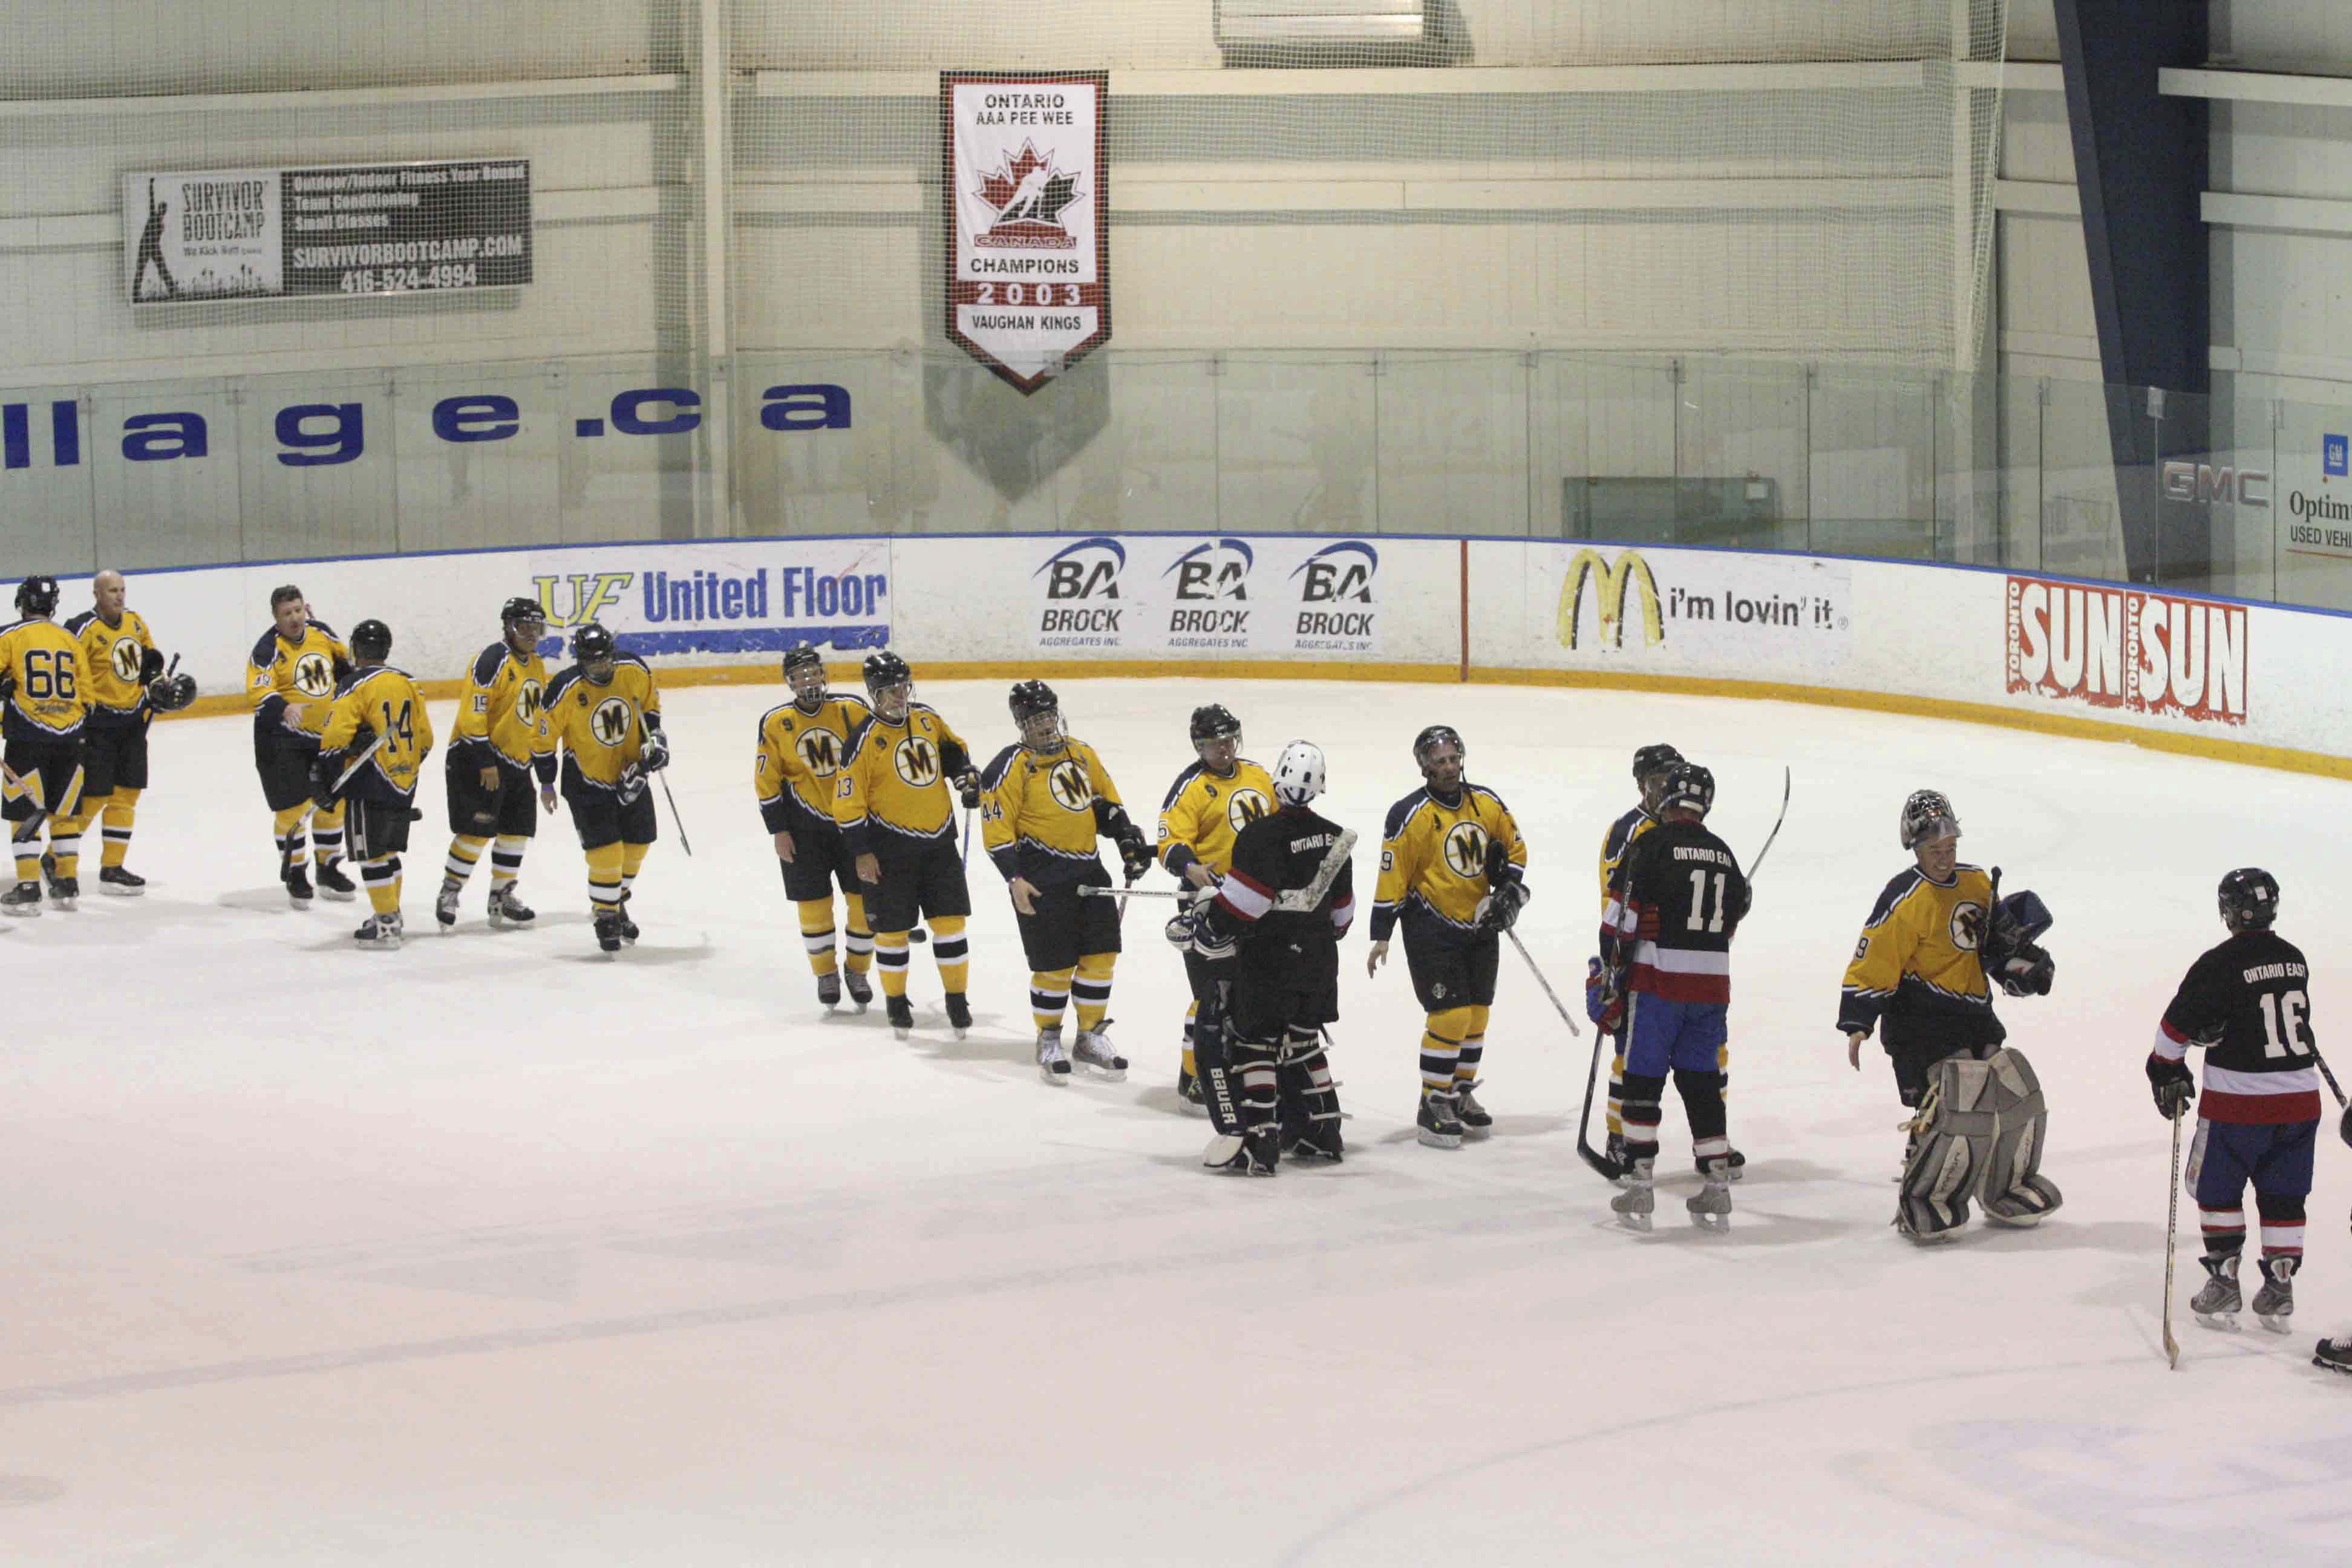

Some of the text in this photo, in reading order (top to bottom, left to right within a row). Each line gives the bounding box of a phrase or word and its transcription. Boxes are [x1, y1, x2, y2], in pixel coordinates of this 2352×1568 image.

[984, 94, 1065, 109] ONTARIO
[976, 111, 1074, 126] AAA PEE WEE
[182, 181, 264, 213] SURVIVOR
[183, 212, 266, 241] BOOTCAMP
[975, 235, 1076, 249] CANADA
[292, 235, 523, 269] SURVIVORBOOTCAMP.COM
[970, 258, 1080, 274] CHAMPIONS
[341, 264, 477, 293] 416-524-4994
[976, 283, 1081, 305] 2003
[972, 315, 1082, 330] VAUGHAN KINGS
[2163, 461, 2270, 508] GMC
[2289, 490, 2352, 523] Optim
[2290, 524, 2352, 547] USED VEHI
[642, 566, 887, 623] United Floor
[1047, 561, 1120, 599] BA
[1175, 561, 1247, 601] BA
[1301, 563, 1372, 604] BA
[532, 572, 634, 628] UF
[1670, 587, 1714, 621] i'm
[1041, 609, 1123, 632] BROCK
[1169, 609, 1250, 633] BROCK
[1296, 612, 1375, 636] BROCK
[2008, 581, 2021, 683] TORONTO
[1039, 637, 1102, 647] AGGREGATES
[1168, 638, 1229, 647] AGGREGATES
[2020, 583, 2123, 699] SUN
[2126, 596, 2140, 701] TORONTO
[2139, 597, 2246, 714] SUN
[25, 649, 76, 700] 66
[302, 659, 327, 690] M
[474, 694, 488, 713] 15
[382, 699, 414, 754] 14
[601, 705, 624, 740] M
[805, 735, 835, 769] M
[904, 742, 933, 780] M
[837, 777, 852, 799] 13
[1056, 766, 1089, 805] M
[982, 799, 1003, 823] 44
[1236, 795, 1264, 823] M
[1454, 829, 1483, 870] M
[1673, 846, 1716, 863] ONTARIO
[1687, 869, 1726, 933] 11
[2243, 962, 2306, 984] ONTARIO EAST
[2259, 990, 2310, 1059] 16
[1210, 1067, 1238, 1124] BAUER
